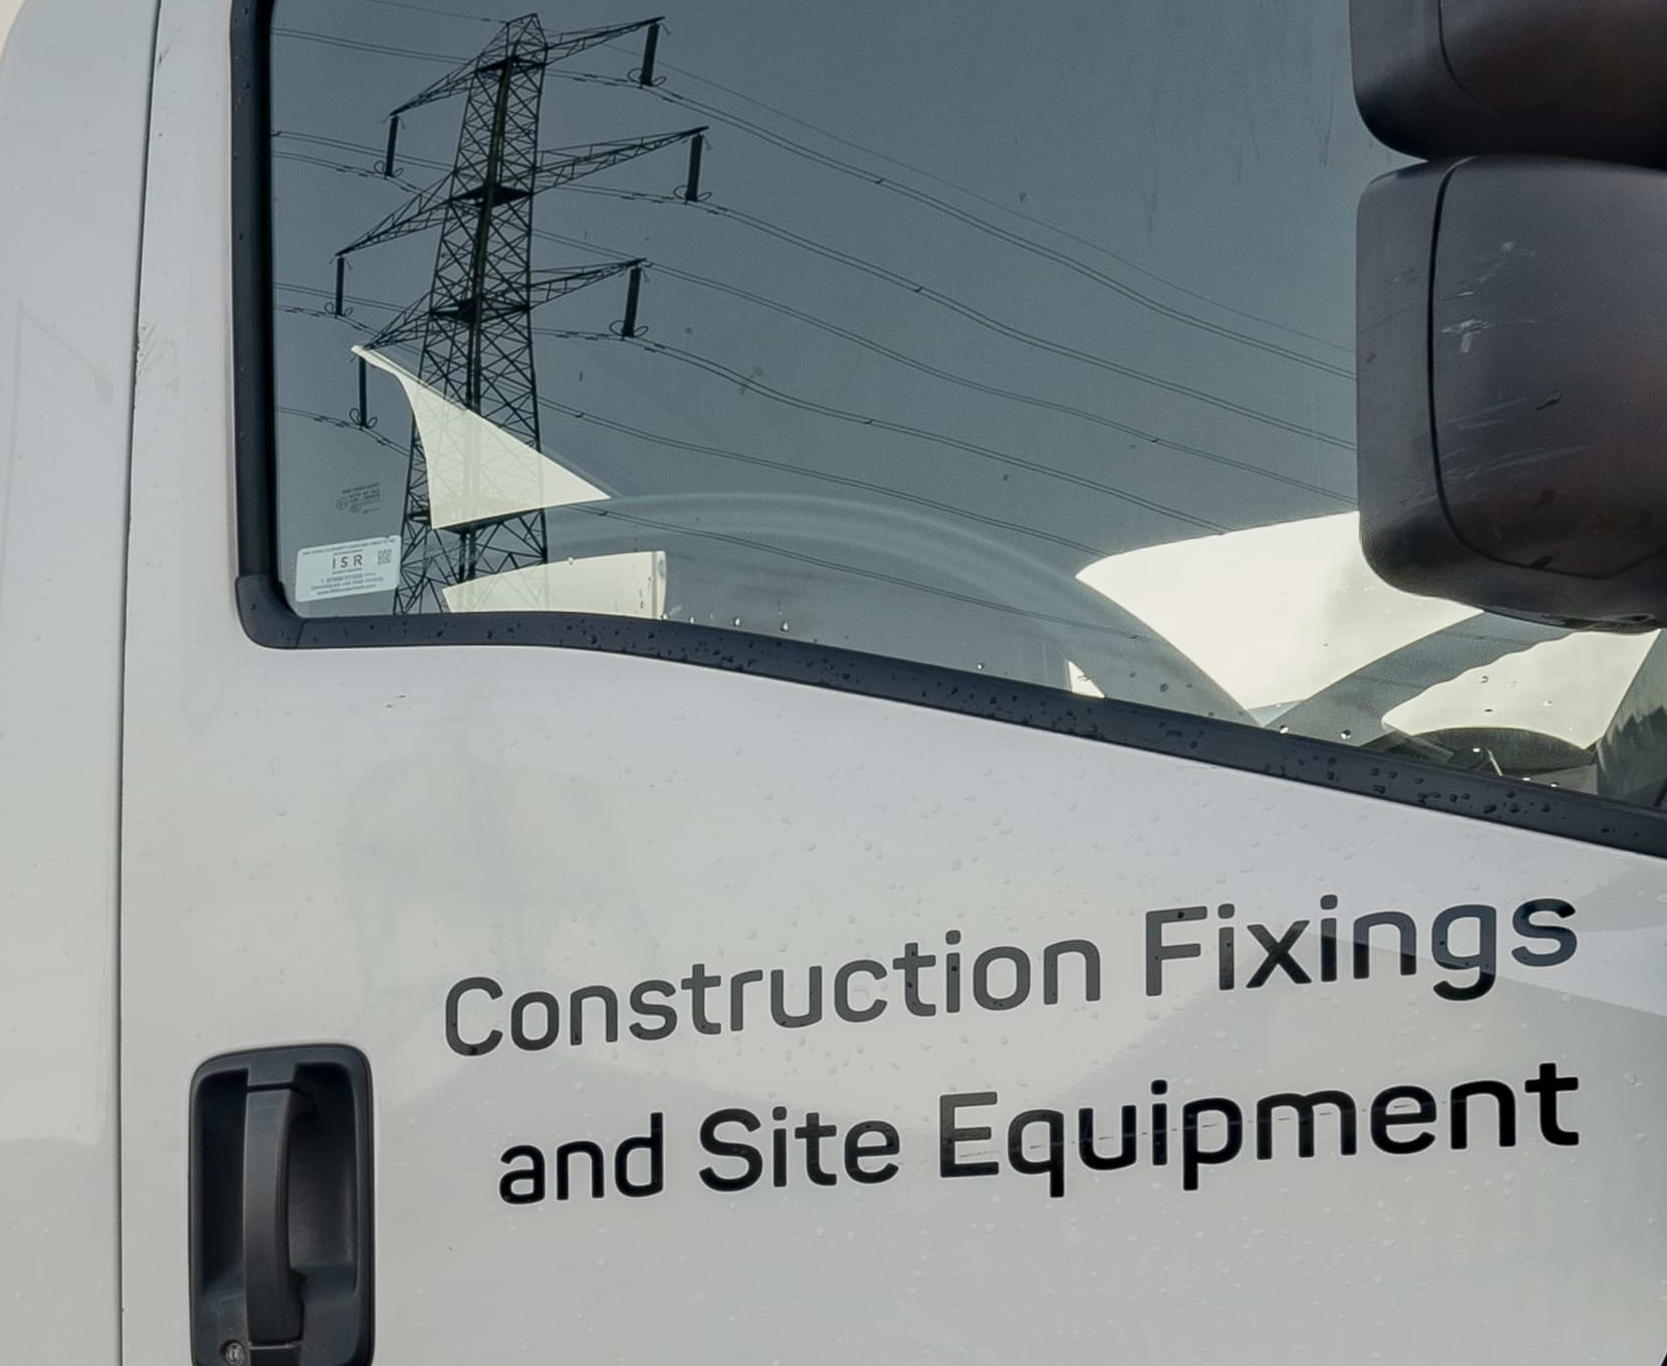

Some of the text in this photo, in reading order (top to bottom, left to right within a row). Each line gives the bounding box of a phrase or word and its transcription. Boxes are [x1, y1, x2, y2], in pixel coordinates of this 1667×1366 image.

[444, 894, 1579, 1056] Construction Fixings
[499, 1062, 1580, 1206] and Site Equipment
